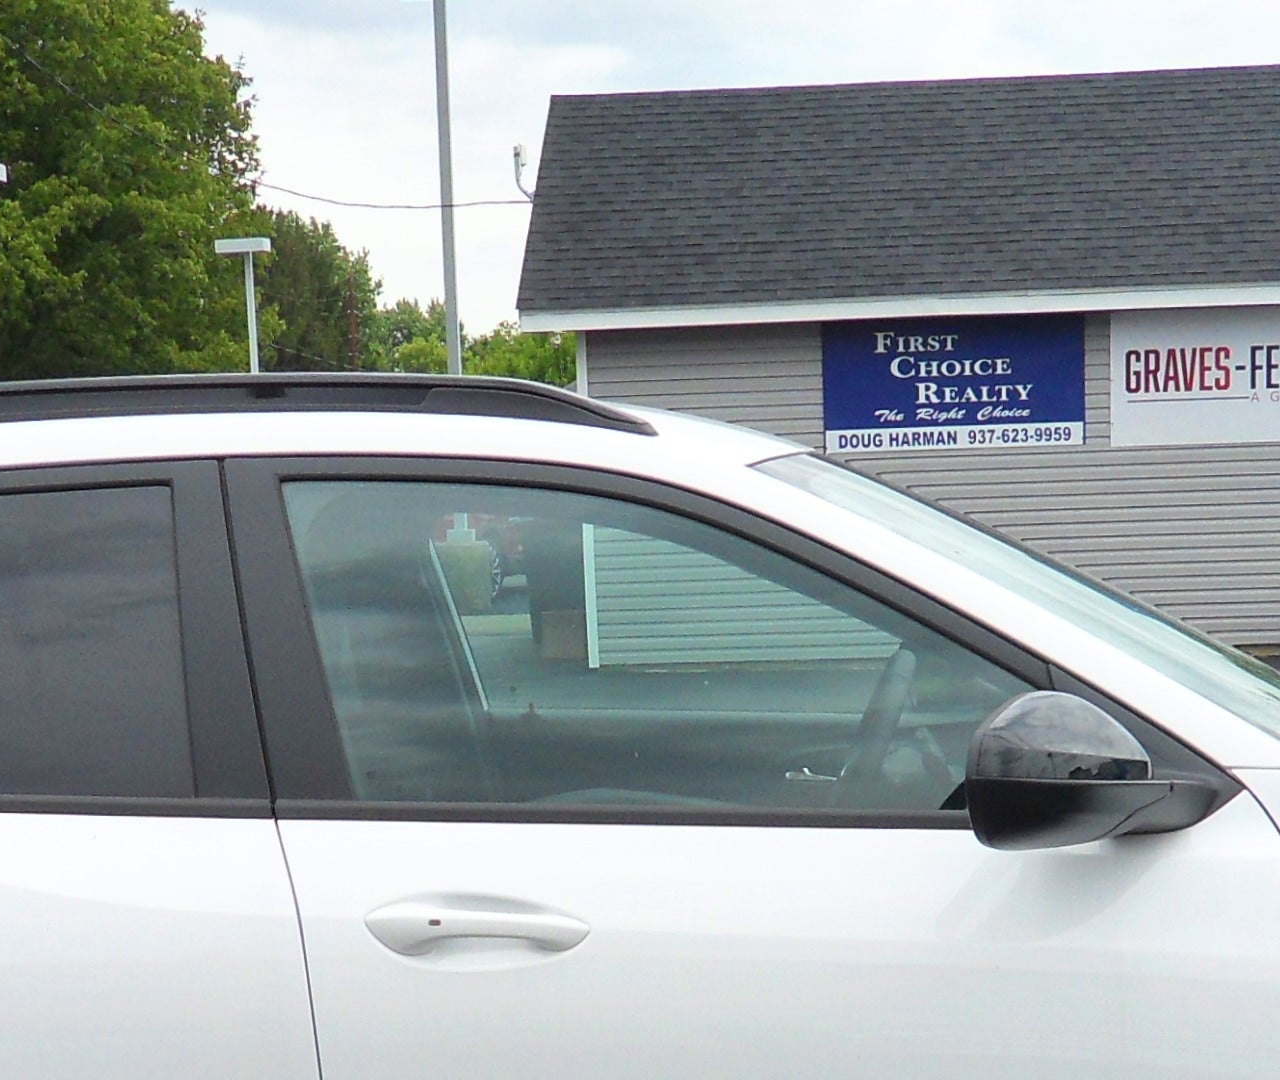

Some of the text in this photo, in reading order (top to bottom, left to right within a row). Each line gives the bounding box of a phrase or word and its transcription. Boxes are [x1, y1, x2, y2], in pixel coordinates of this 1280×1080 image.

[873, 331, 959, 354] FIRST
[889, 356, 1012, 379] CHOICE
[915, 382, 1034, 405] REALTY
[874, 405, 1032, 423] The Right Choice
[838, 426, 1072, 450] DOUG HARMAN 937-623-9959
